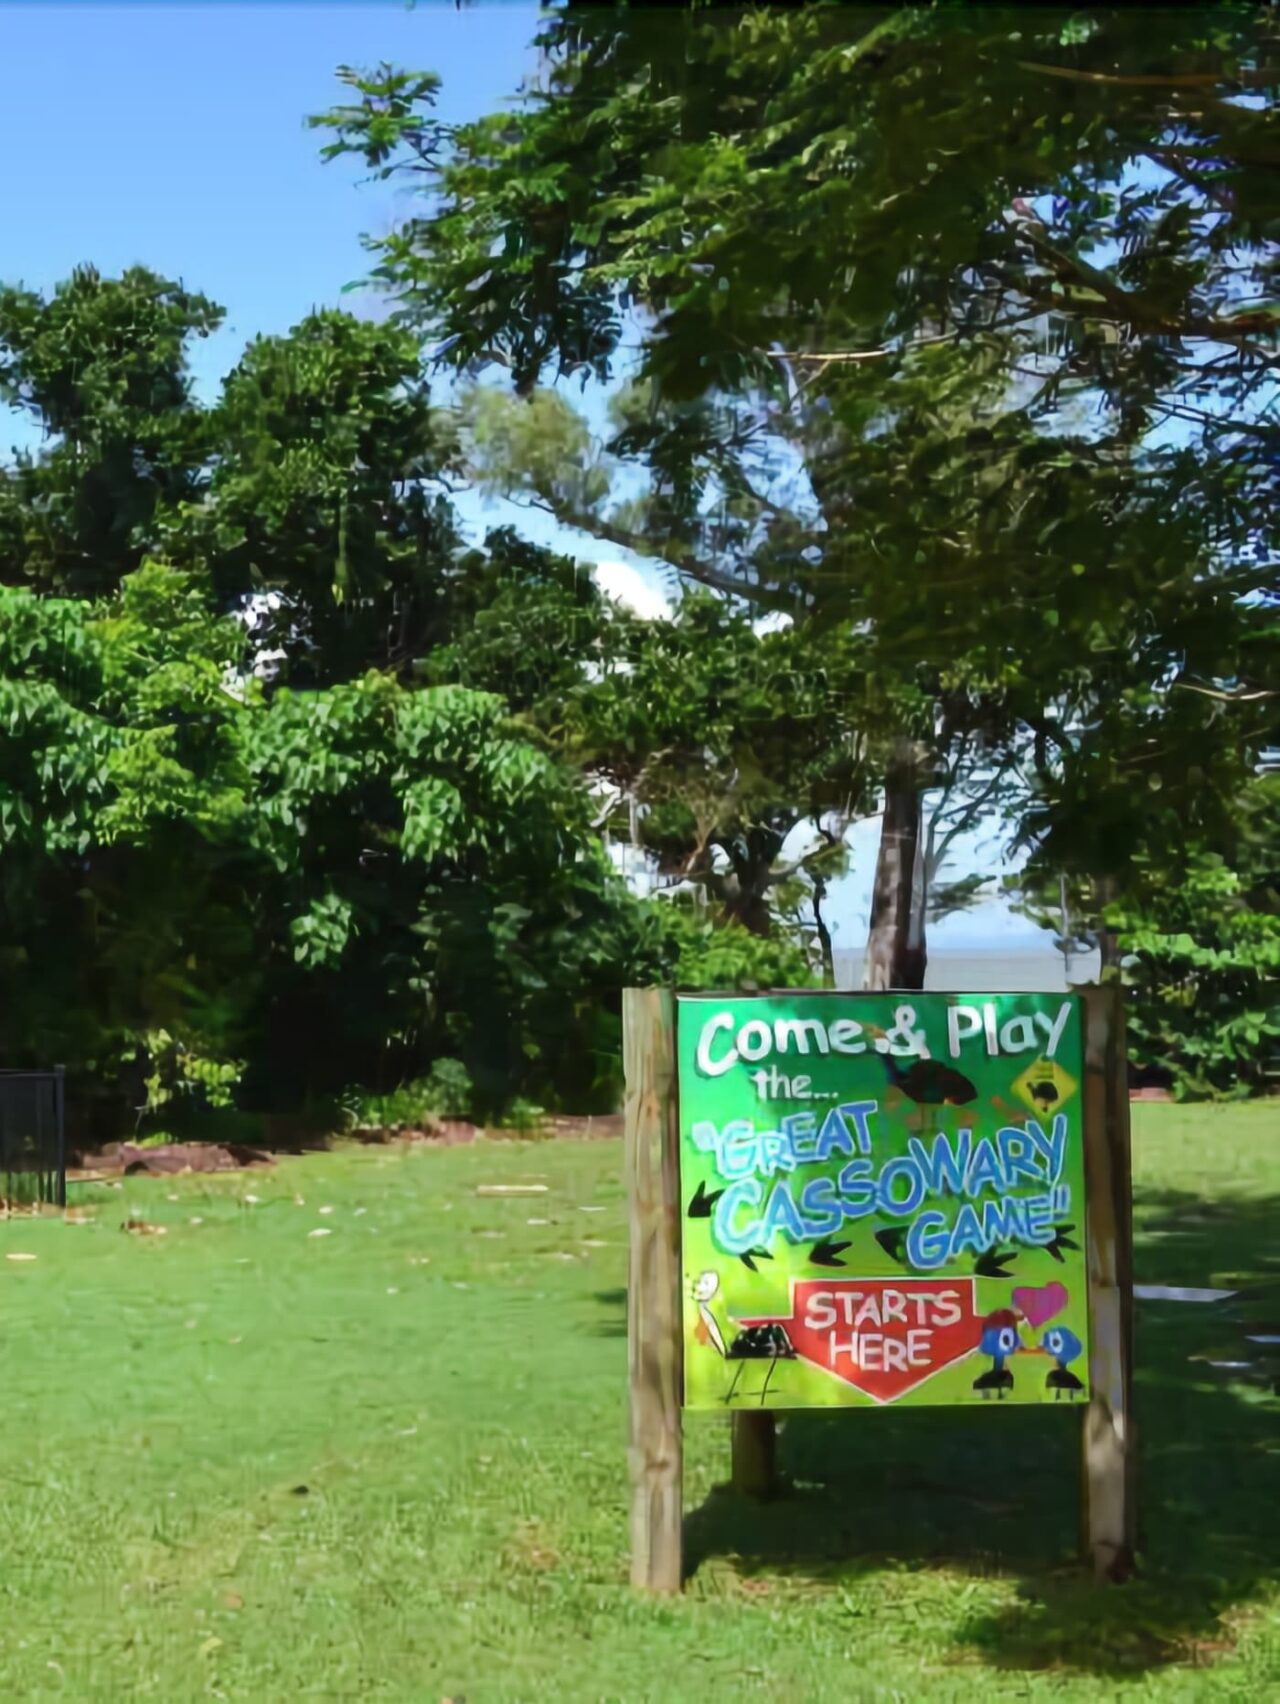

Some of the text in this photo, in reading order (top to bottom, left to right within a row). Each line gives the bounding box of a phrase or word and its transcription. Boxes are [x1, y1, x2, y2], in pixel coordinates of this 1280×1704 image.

[697, 1002, 1071, 1075] Come & Play
[712, 1113, 1067, 1255] CASSOWARY
[805, 1289, 961, 1330] STARTS
[830, 1329, 934, 1373] HERE
